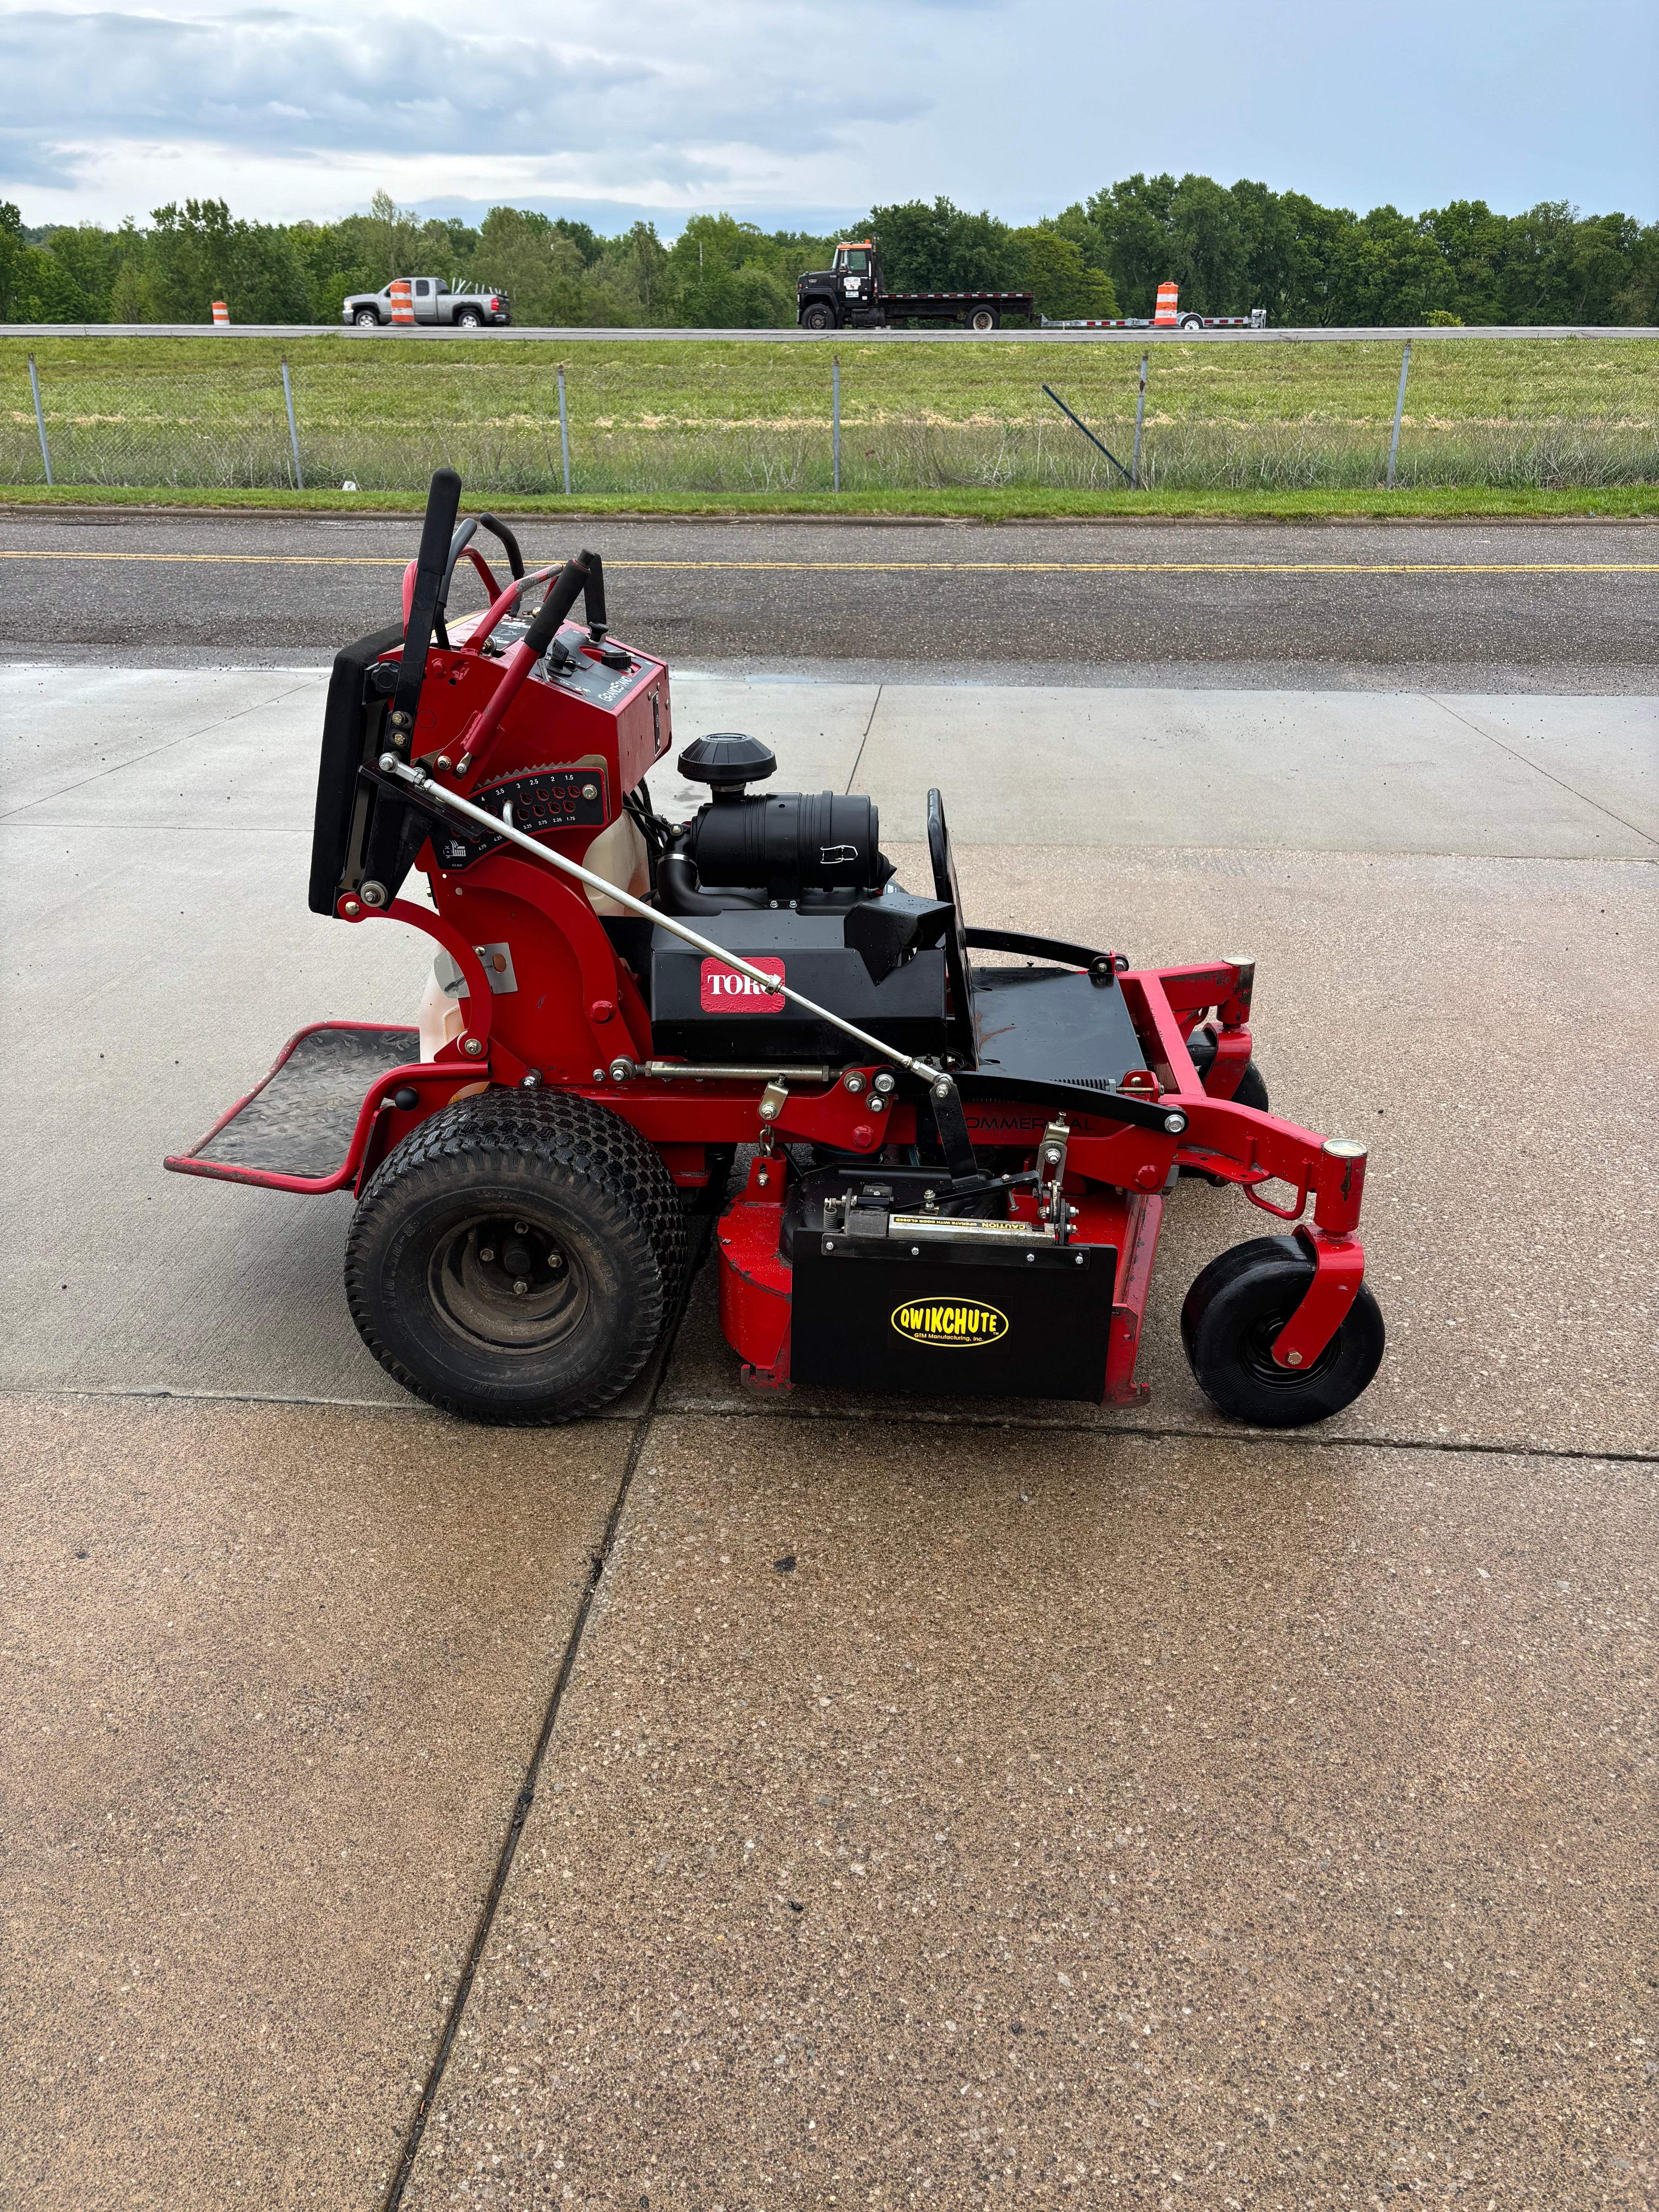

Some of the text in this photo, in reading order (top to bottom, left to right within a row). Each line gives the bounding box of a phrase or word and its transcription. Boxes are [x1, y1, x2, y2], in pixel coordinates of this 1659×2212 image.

[708, 974, 782, 995] TOR
[965, 1117, 1096, 1131] OMMERAL
[900, 1306, 997, 1334] QWIKCHUTE
[928, 1333, 971, 1342] Manufacturing,
